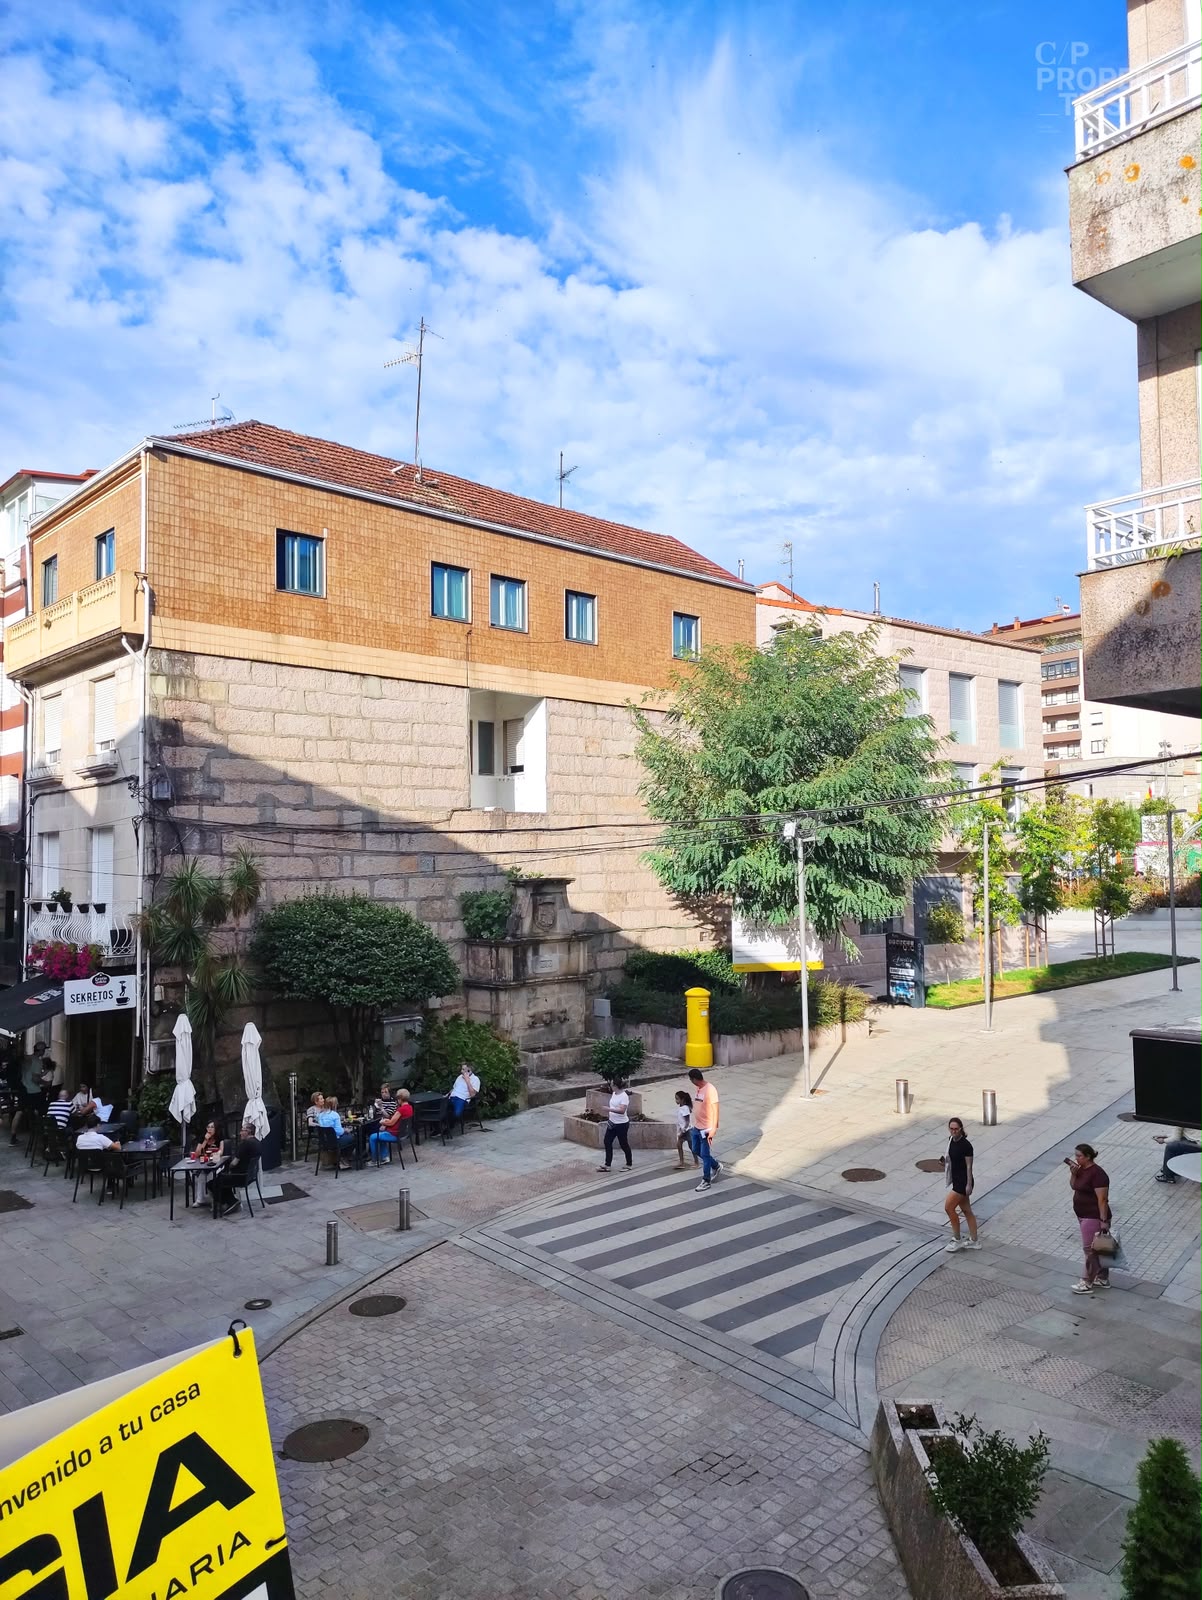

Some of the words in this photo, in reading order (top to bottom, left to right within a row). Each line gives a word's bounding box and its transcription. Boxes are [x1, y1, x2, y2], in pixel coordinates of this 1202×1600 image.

[70, 990, 114, 1003] SEKRETOS
[100, 1436, 113, 1454] a
[118, 1416, 144, 1441] tu
[150, 1382, 201, 1422] casa
